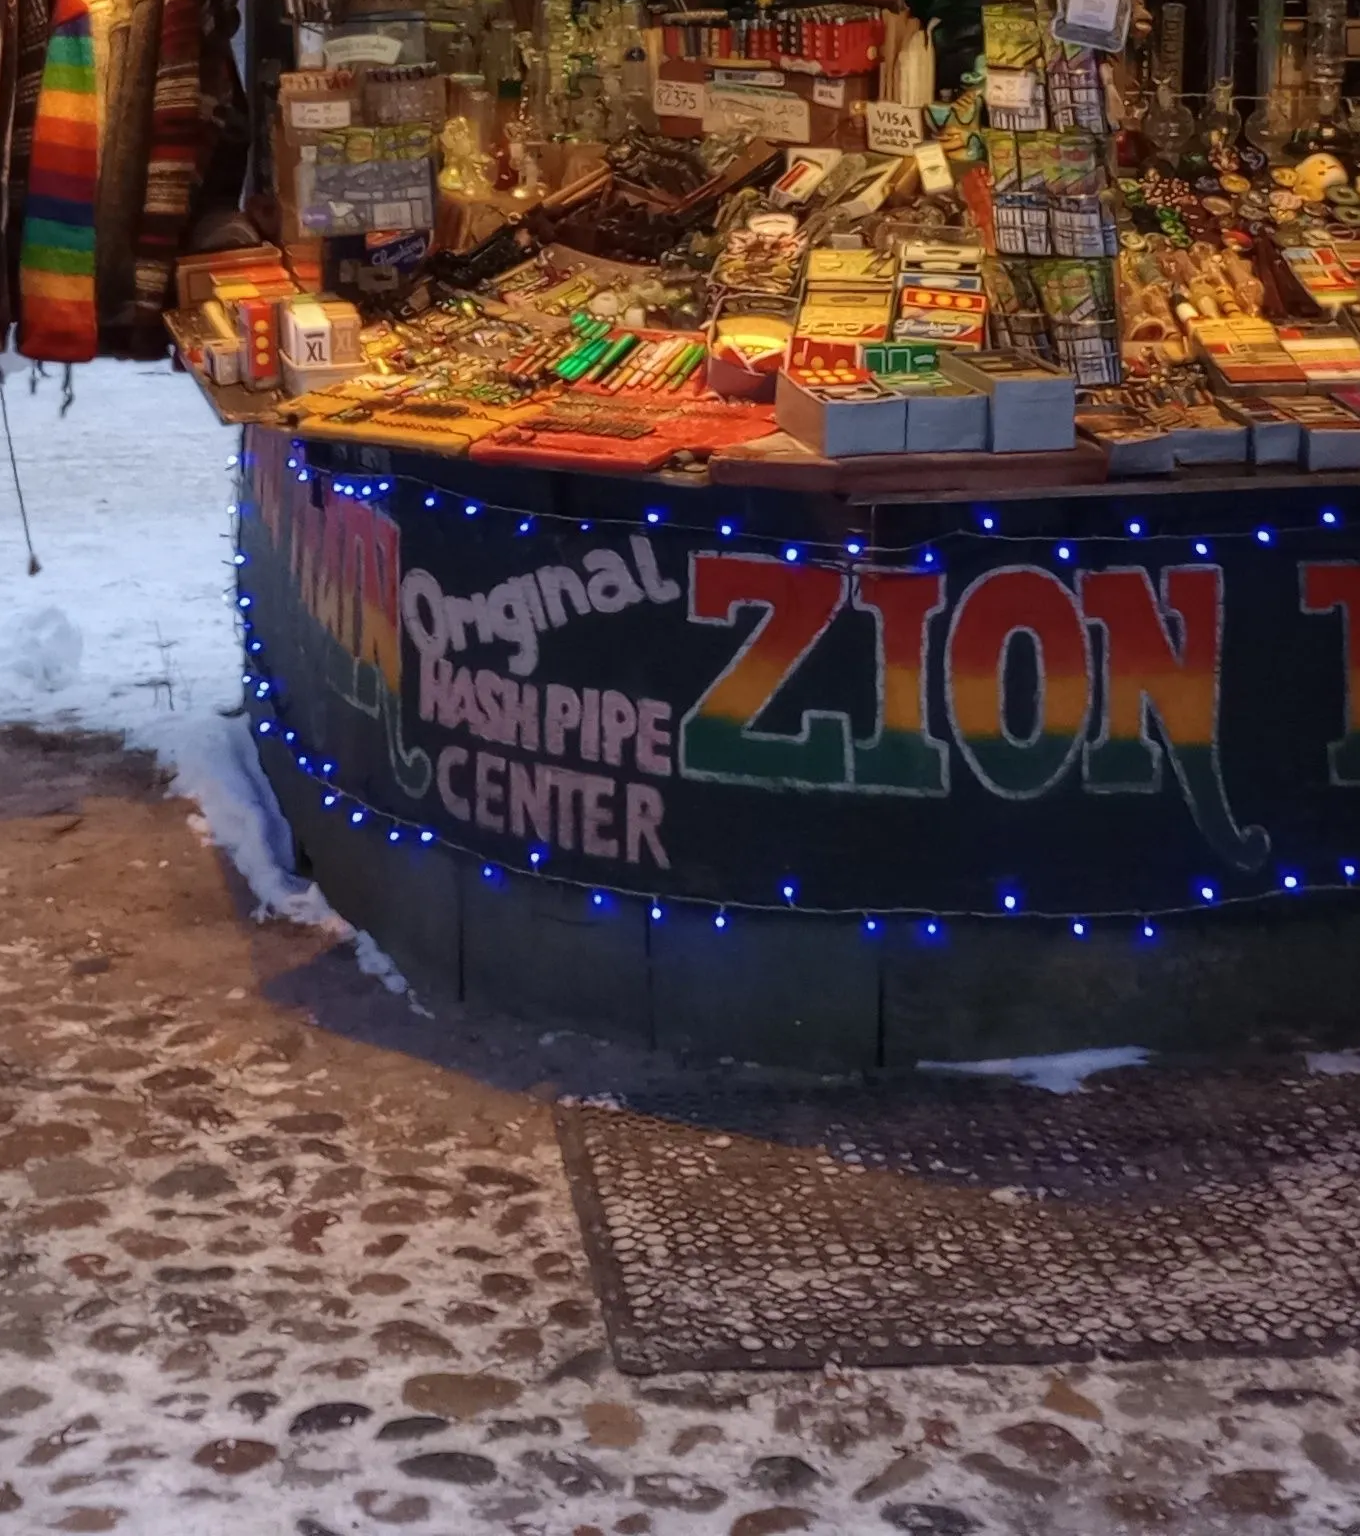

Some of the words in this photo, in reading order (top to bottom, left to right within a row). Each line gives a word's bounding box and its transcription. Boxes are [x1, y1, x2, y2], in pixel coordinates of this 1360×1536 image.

[876, 109, 913, 129] VISA
[306, 340, 328, 362] XL
[401, 535, 681, 676] Original
[419, 654, 539, 751] HASH
[544, 683, 672, 776] PIPE
[678, 544, 1269, 863] ZION
[437, 746, 671, 869] CENTER
